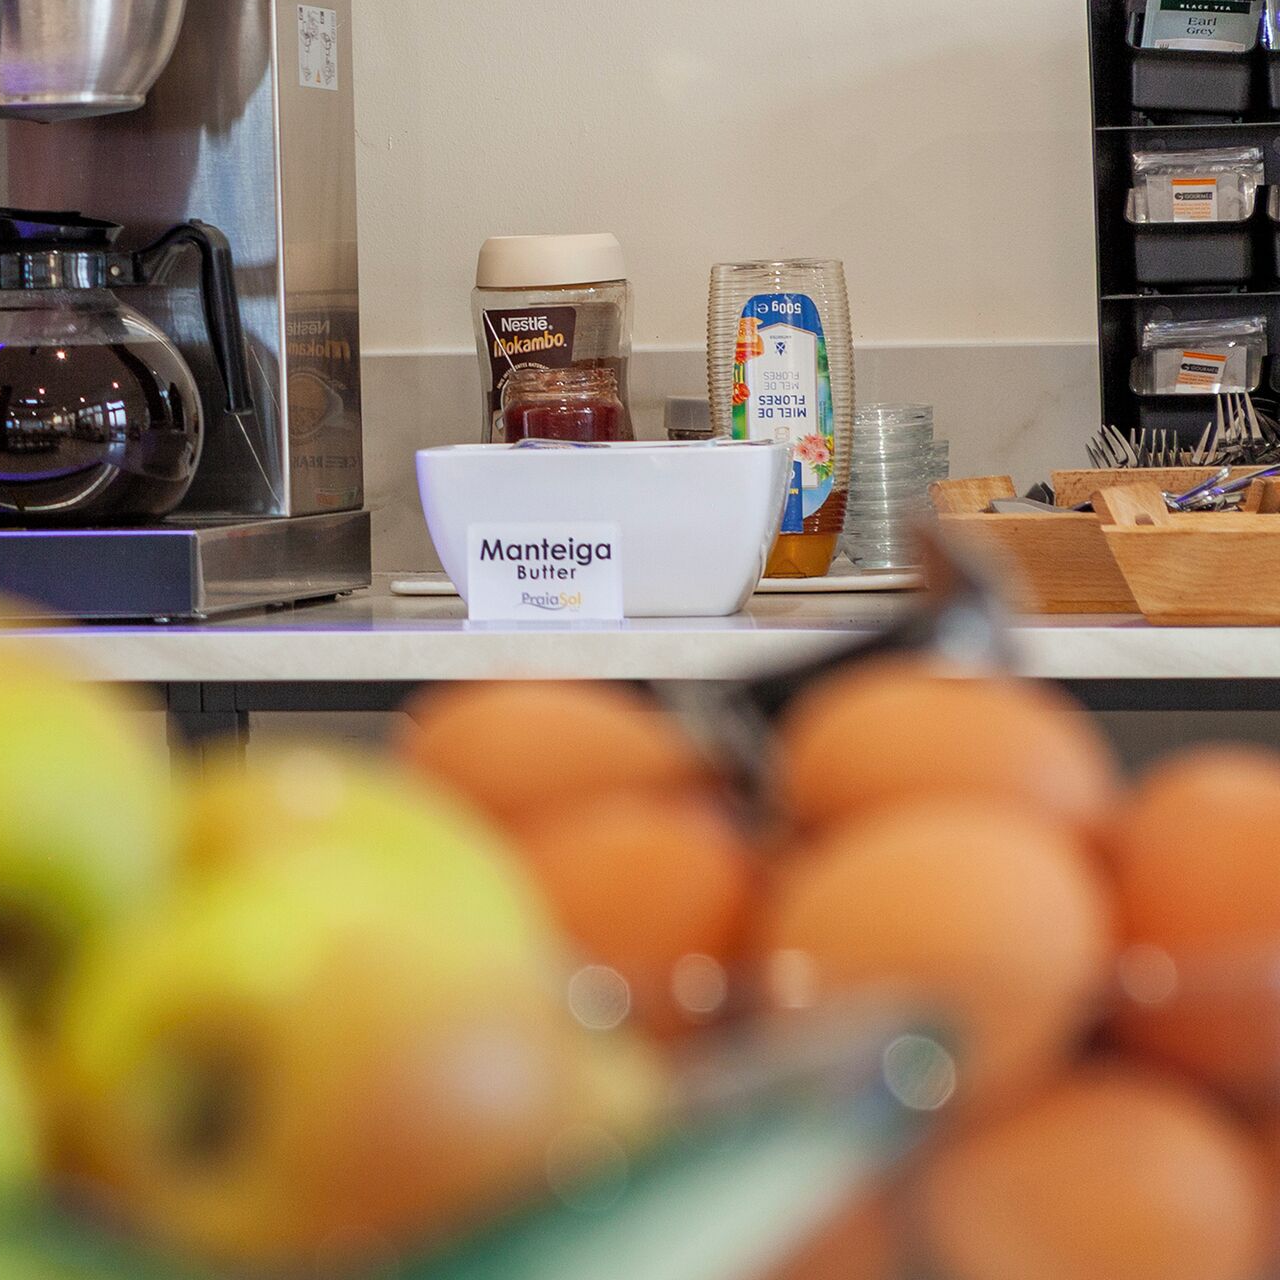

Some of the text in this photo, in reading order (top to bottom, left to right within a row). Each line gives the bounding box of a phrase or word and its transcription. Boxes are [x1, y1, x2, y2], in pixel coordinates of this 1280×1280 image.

[1188, 17, 1217, 26] Earl
[1186, 26, 1216, 36] Grey
[772, 300, 802, 314] 500g
[763, 372, 800, 380] FLORES
[764, 382, 800, 390] MEL DE
[758, 395, 806, 406] FLORES
[758, 408, 807, 418] MIEL DE
[480, 537, 612, 566] Manteiga
[517, 564, 577, 580] Butter
